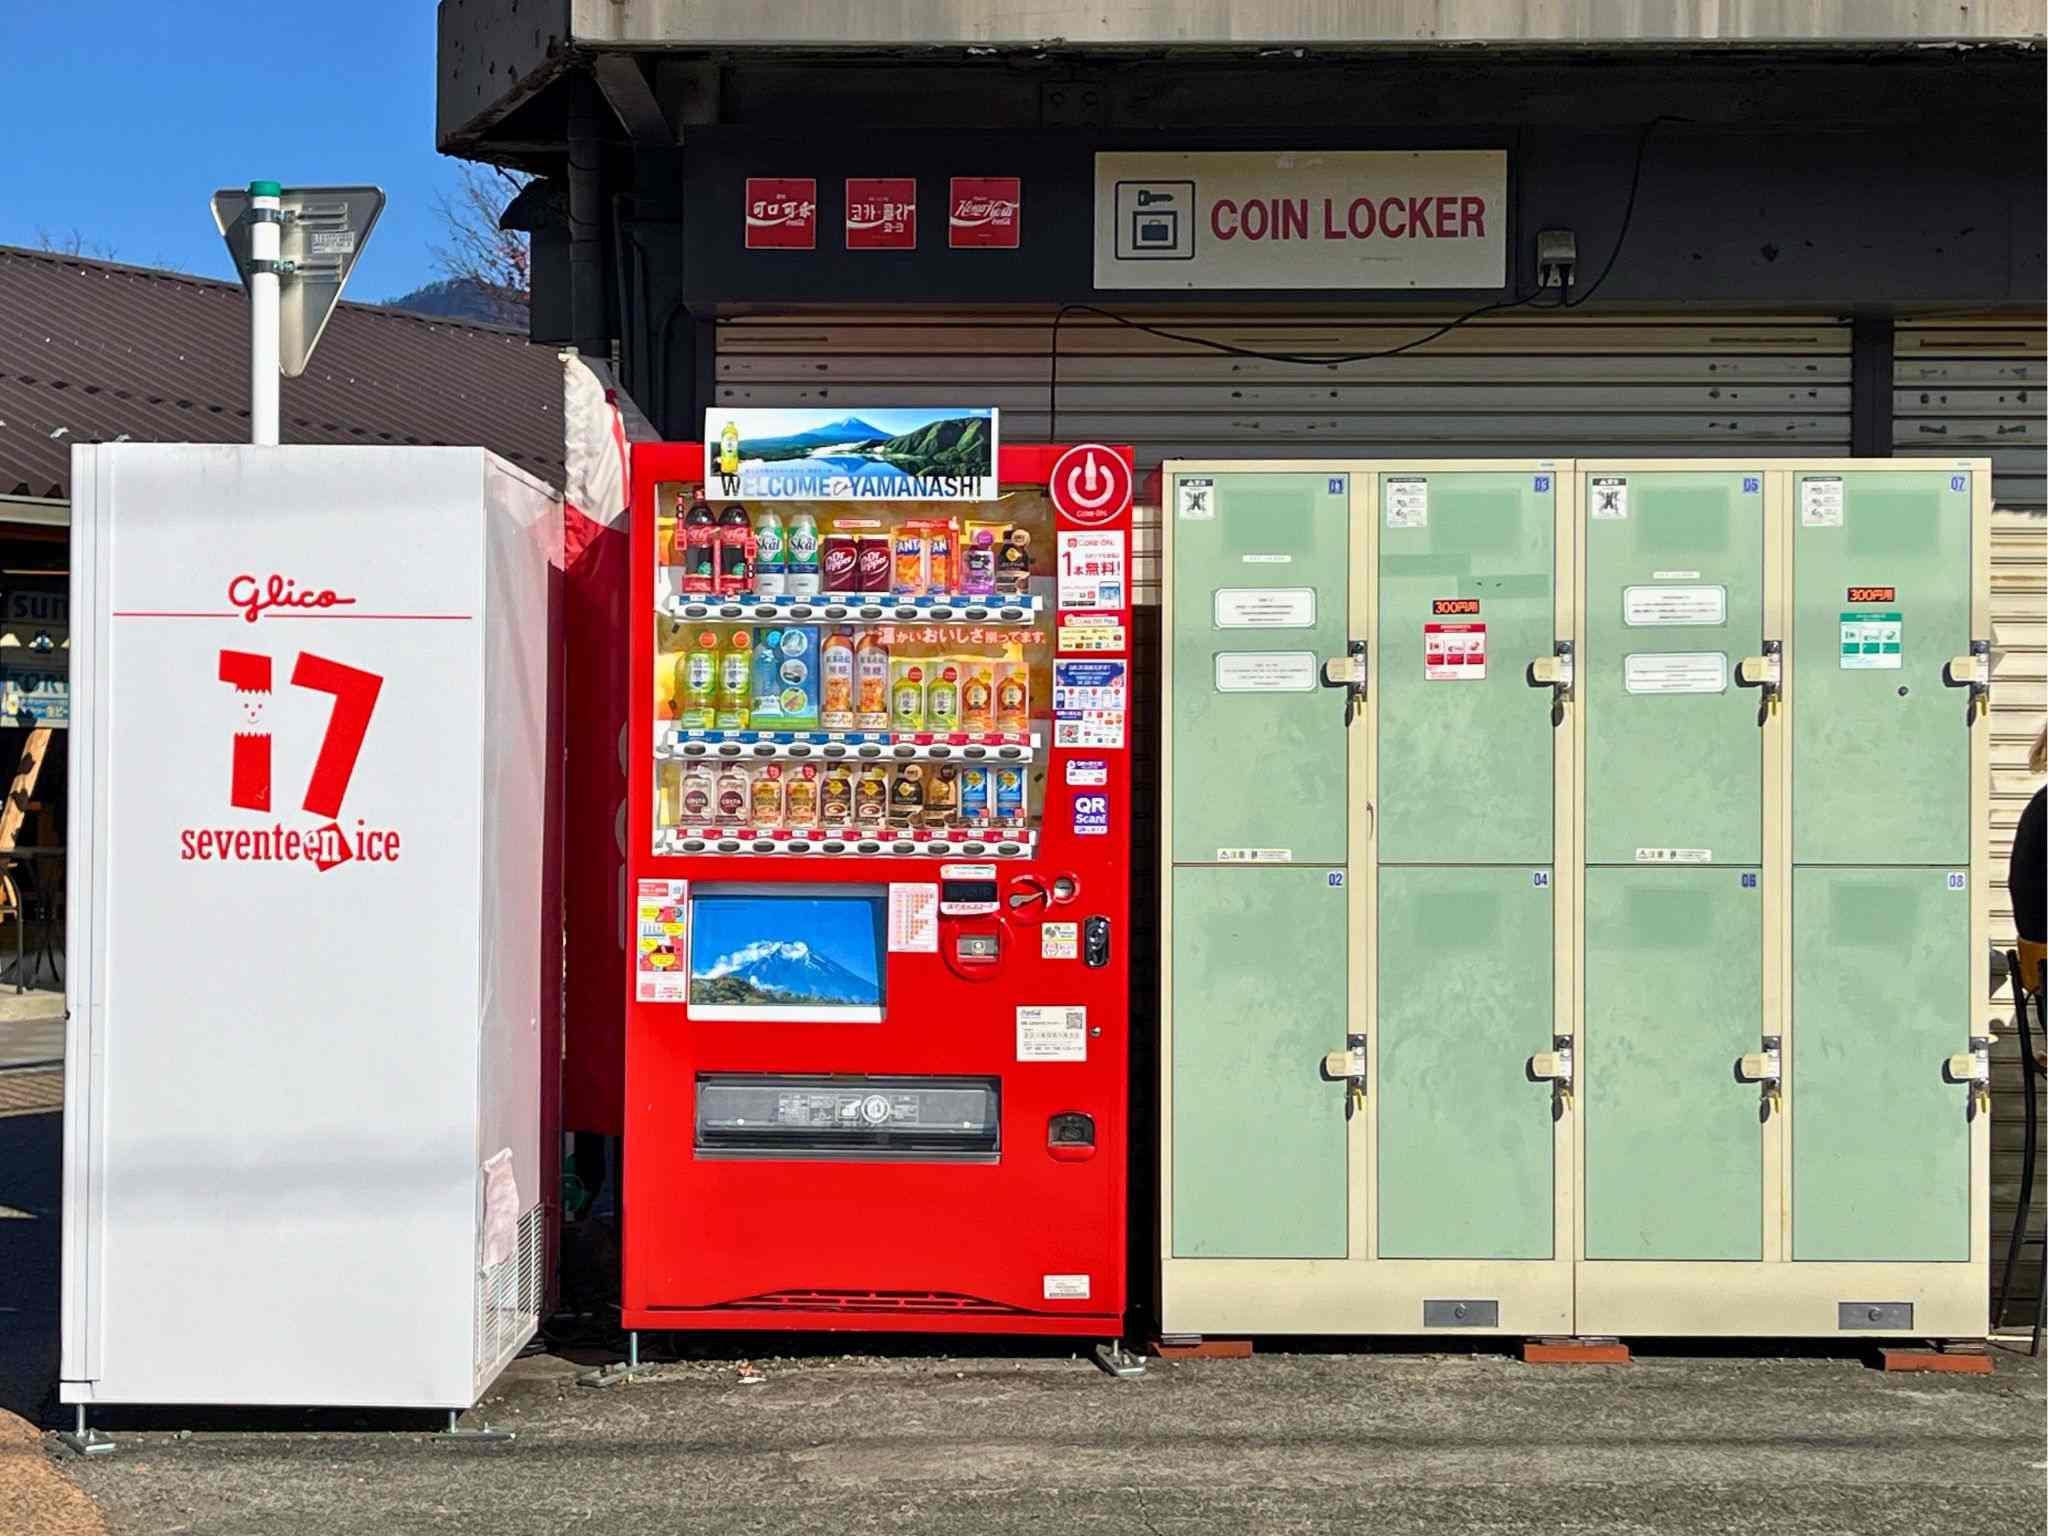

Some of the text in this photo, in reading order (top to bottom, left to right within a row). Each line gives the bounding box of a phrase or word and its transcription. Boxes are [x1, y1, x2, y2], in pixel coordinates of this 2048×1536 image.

[1211, 196, 1485, 241] COIN LOCKER
[721, 476, 831, 498] WELCOME
[850, 474, 982, 497] YAMANASHI
[1329, 479, 1344, 494] 01
[1743, 478, 1759, 492] 05
[1950, 476, 1966, 491] 07
[228, 574, 356, 622] Glico
[1075, 797, 1106, 813] QR
[180, 818, 400, 865] seventeen ice
[1328, 872, 1343, 886] 02
[1535, 872, 1548, 886] 04
[1741, 873, 1757, 888] 06
[1950, 874, 1964, 888] 08
